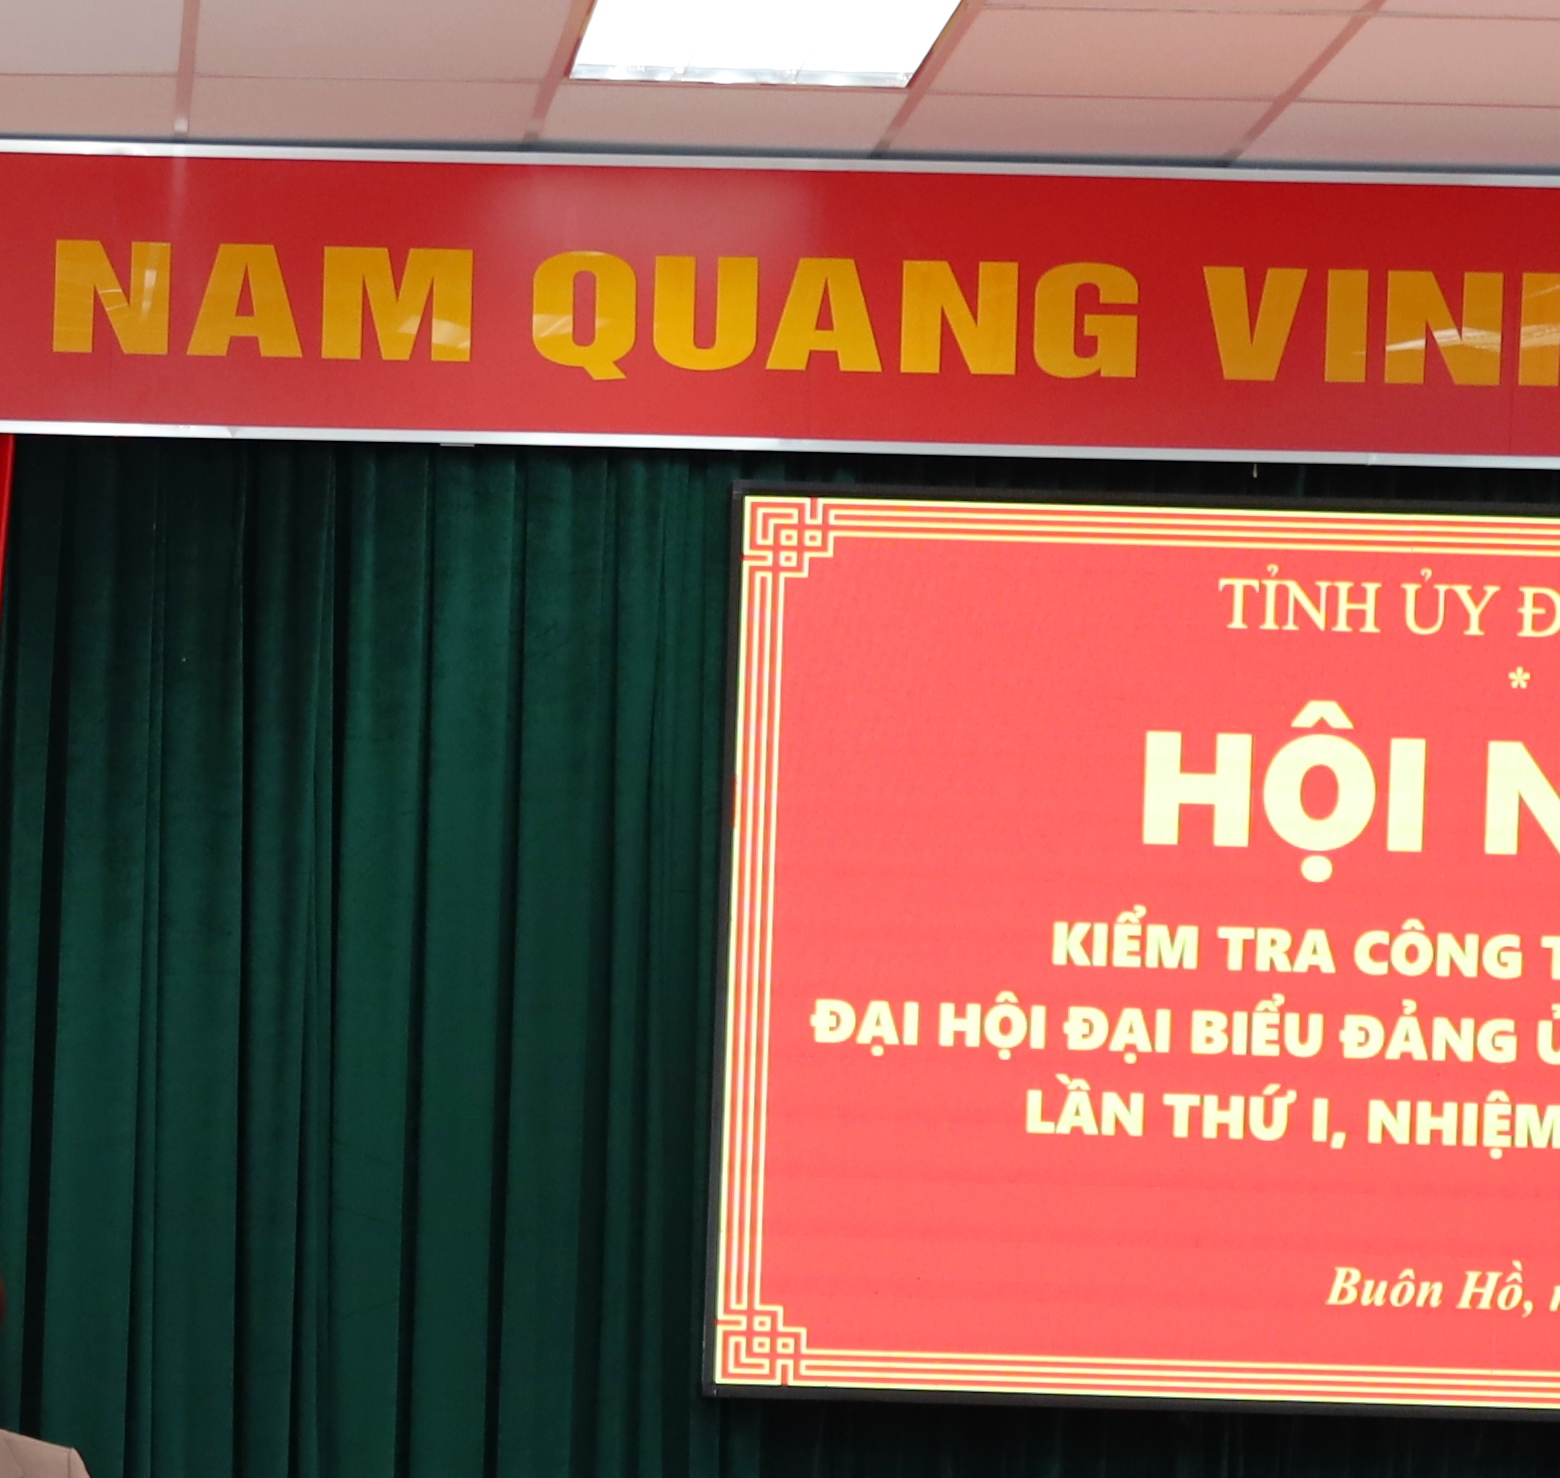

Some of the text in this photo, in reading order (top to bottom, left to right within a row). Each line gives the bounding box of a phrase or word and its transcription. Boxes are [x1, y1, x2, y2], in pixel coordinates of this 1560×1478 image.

[52, 239, 473, 362] NAM
[531, 250, 1138, 381] QUANG
[1219, 564, 1382, 633] TỈNH
[1401, 567, 1500, 635] ỦY
[1143, 700, 1426, 882] HỘI
[1052, 904, 1198, 969] KIỂM
[1217, 926, 1336, 973] TRA
[1354, 918, 1522, 979] CÔNG
[810, 999, 919, 1056] ĐẠI
[938, 991, 1046, 1060] HỘI
[1063, 1006, 1171, 1064] ĐẠI
[1191, 993, 1324, 1057] BIỂU
[1339, 999, 1517, 1063] ĐẢNG
[1026, 1073, 1144, 1136] LẦN
[1163, 1084, 1297, 1141] THỨ
[1312, 1098, 1346, 1149] I,
[1326, 1267, 1443, 1307] Buôn
[1457, 1260, 1533, 1317] Hồ,
